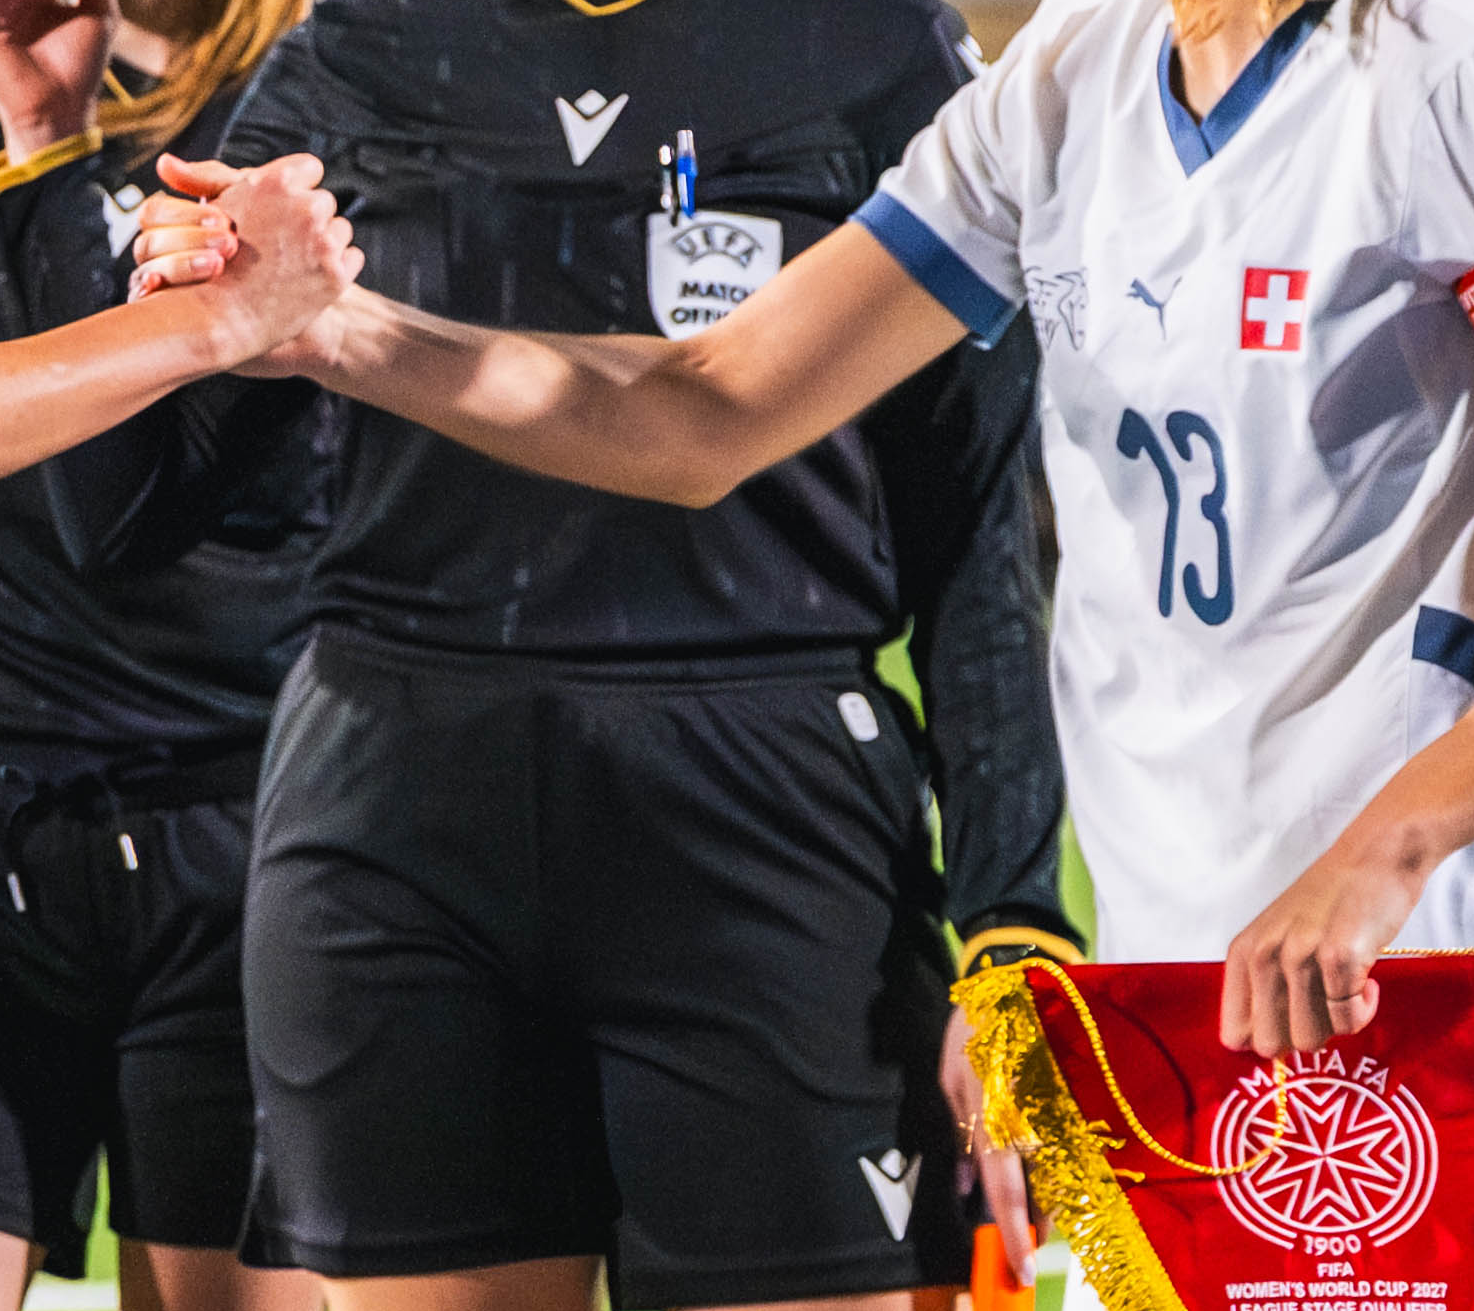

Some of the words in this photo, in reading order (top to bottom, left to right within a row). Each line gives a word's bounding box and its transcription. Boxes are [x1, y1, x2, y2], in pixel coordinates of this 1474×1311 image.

[679, 281, 752, 304] MATC
[671, 306, 729, 324] OFFI
[1116, 407, 1234, 626] 13
[1353, 1056, 1389, 1095] FA
[1303, 1234, 1362, 1256] 1900
[1317, 1262, 1354, 1278] FIFA
[1225, 1281, 1306, 1300] WOMEN'S
[1308, 1280, 1371, 1298] WORLD
[1373, 1280, 1409, 1298] CUP
[1411, 1281, 1448, 1299] 2027
